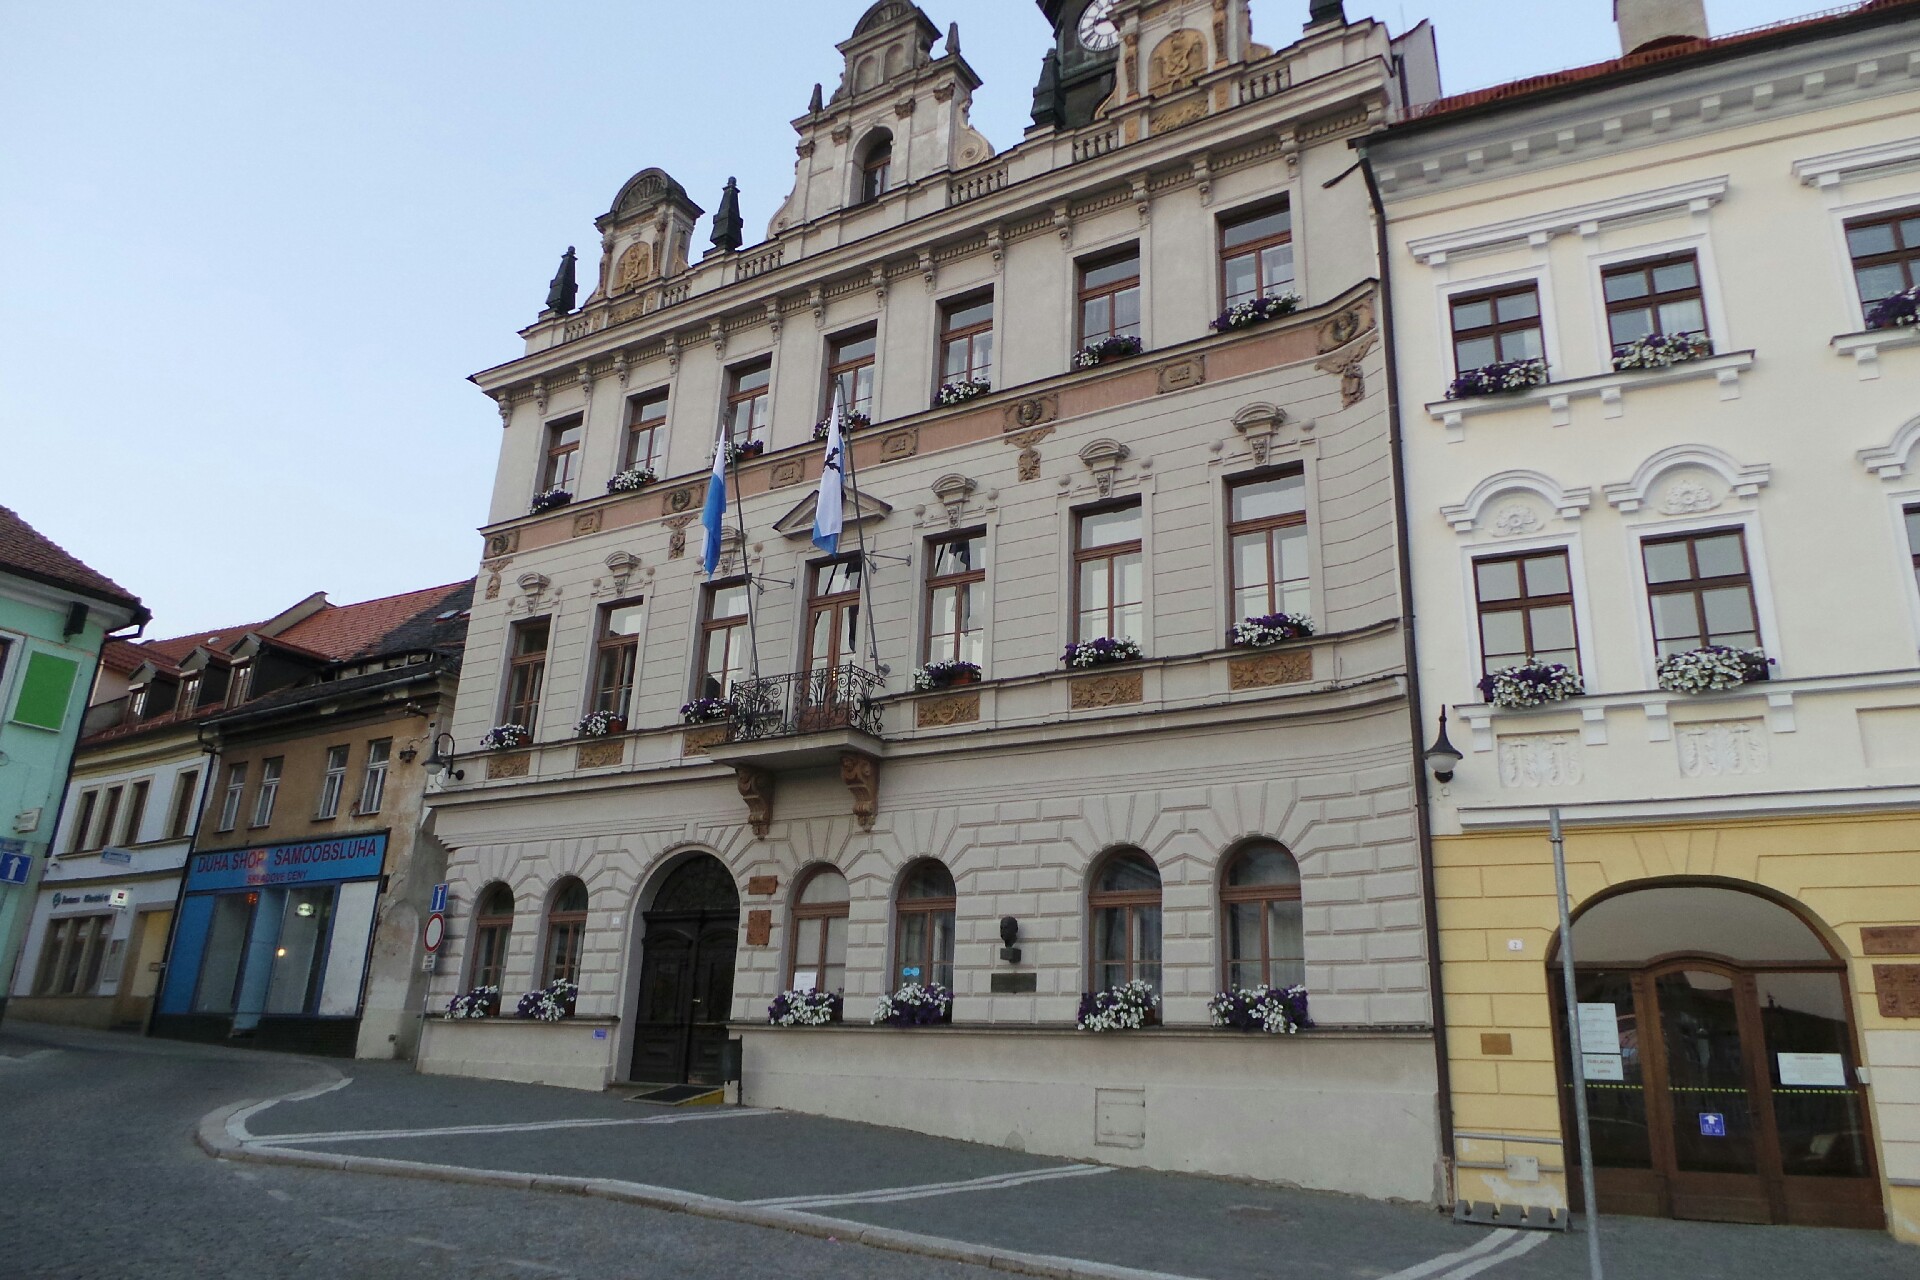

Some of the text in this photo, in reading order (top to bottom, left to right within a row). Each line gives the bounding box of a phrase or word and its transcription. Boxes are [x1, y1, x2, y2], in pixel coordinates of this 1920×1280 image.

[198, 839, 376, 873] DUHA SHOP SAMOOBSLUHA
